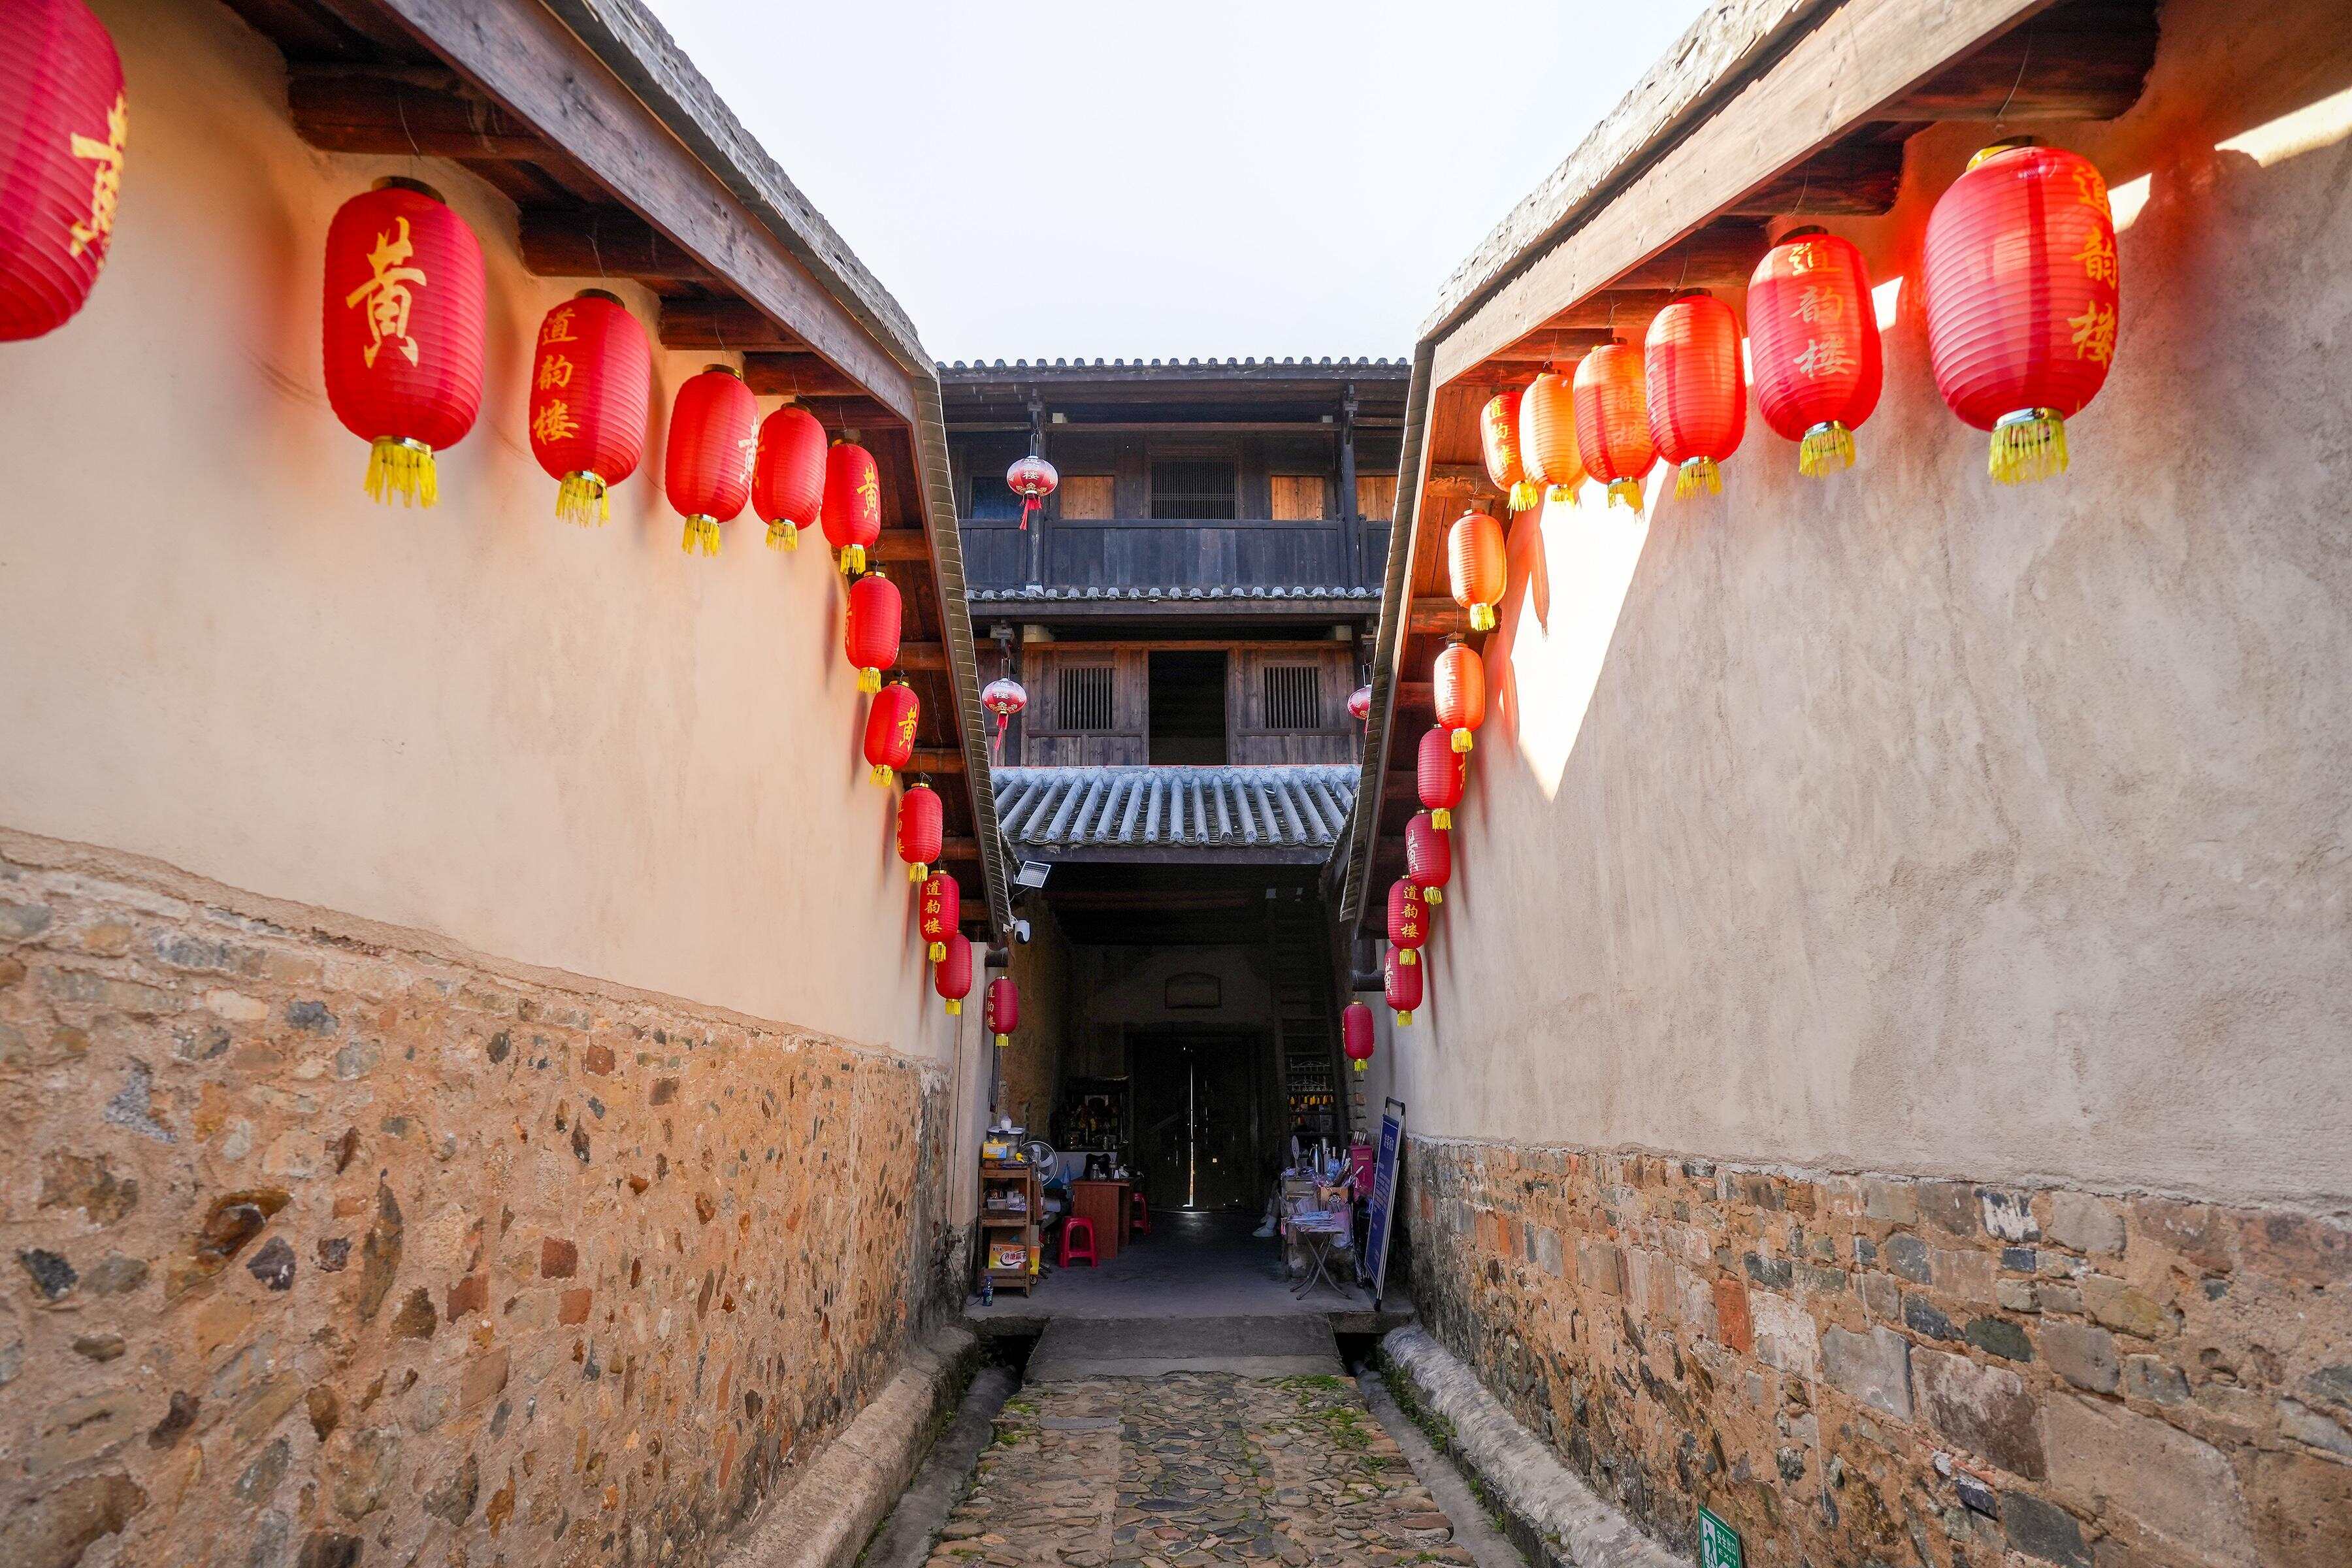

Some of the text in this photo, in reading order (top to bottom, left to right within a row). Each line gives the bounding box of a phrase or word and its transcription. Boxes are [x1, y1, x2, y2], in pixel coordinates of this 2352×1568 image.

[346, 216, 427, 368] 黄
[2068, 165, 2116, 369] 道韵楼
[1788, 240, 1857, 380] 道韵楼
[532, 307, 580, 446] 道韵楼
[857, 461, 879, 523] 黄
[898, 703, 918, 752] 黄
[924, 879, 943, 935] 道韵楼
[1400, 885, 1420, 939] 道韵楼
[1716, 1529, 1737, 1556] 安全出口
[1718, 1547, 1738, 1567] EXIT
